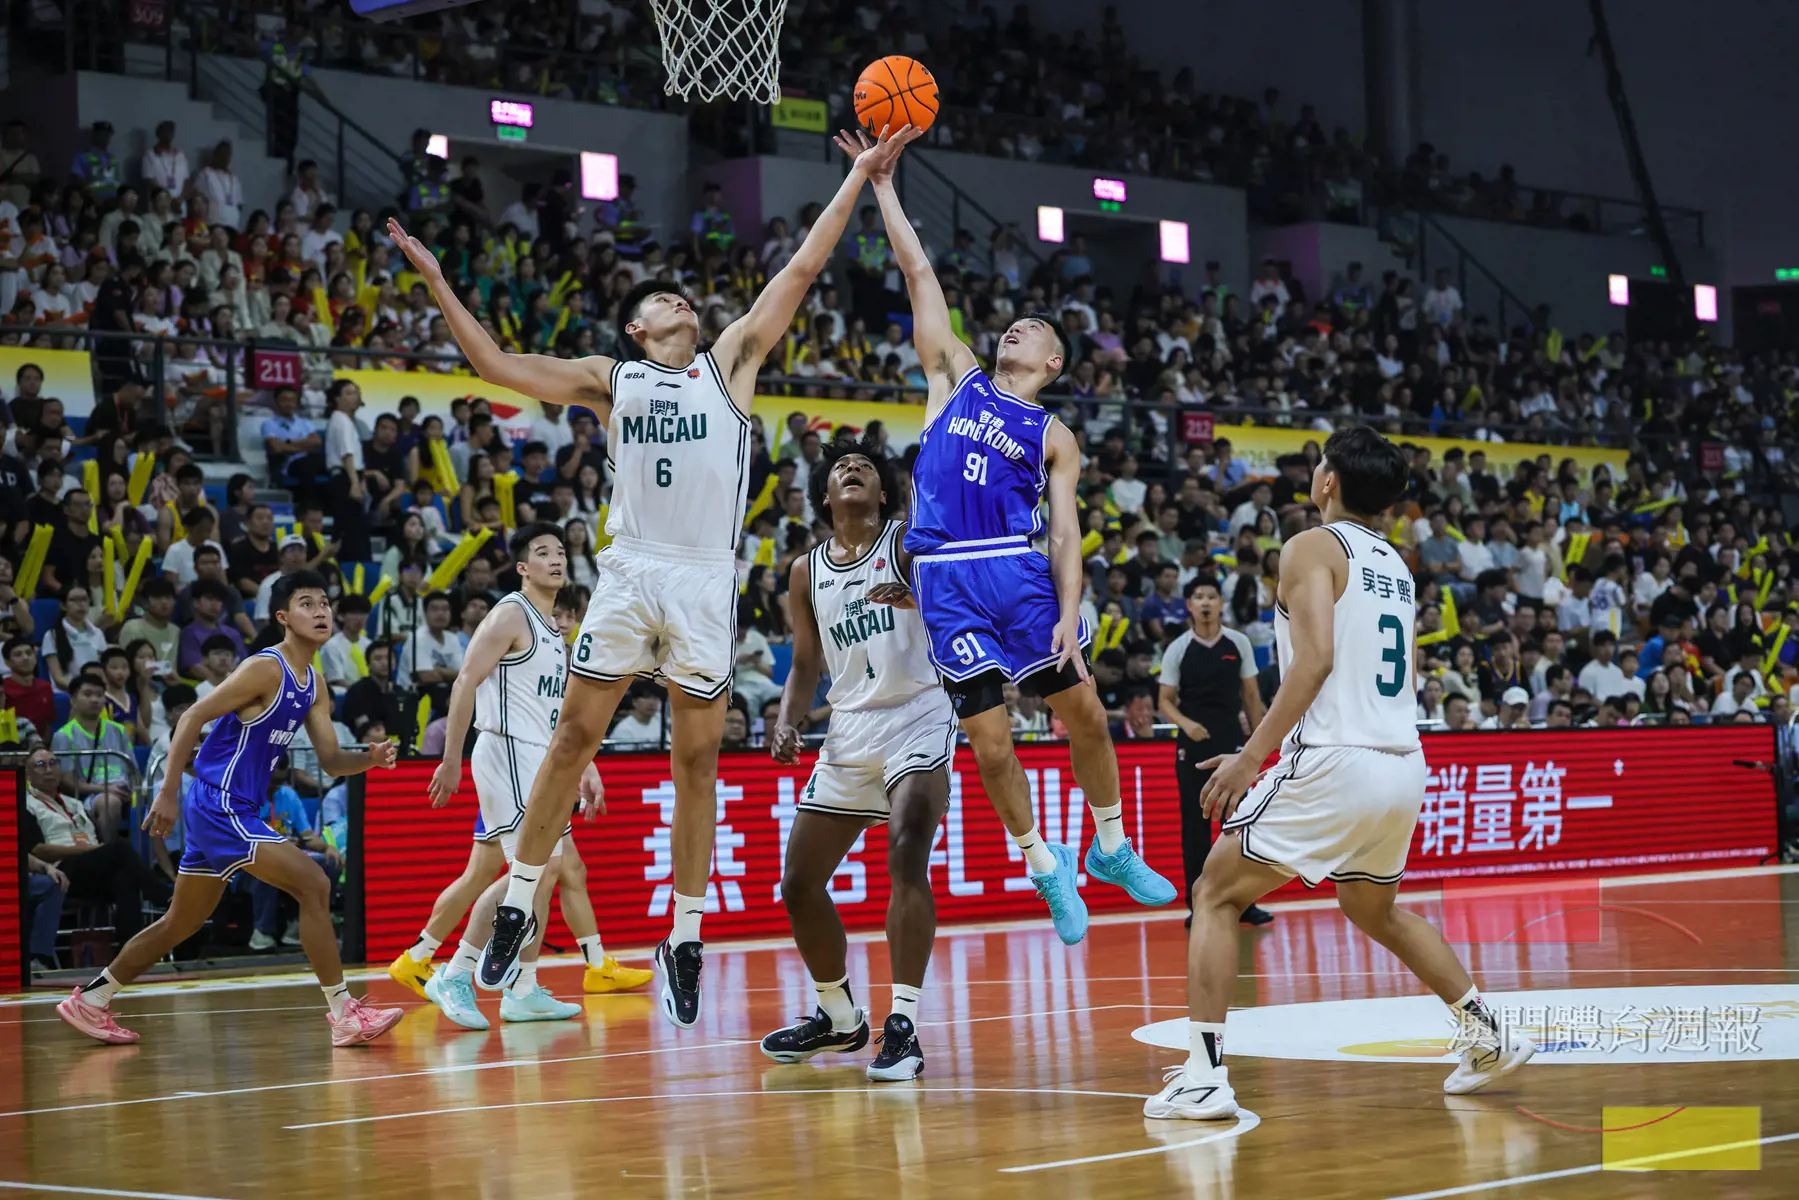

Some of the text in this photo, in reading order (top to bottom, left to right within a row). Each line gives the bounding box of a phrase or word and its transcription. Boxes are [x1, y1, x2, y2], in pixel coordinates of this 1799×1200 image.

[260, 359, 296, 383] 211
[649, 399, 679, 417] 澳門
[979, 410, 1006, 431] 香港
[622, 413, 707, 444] MACAU
[947, 416, 1026, 460] HONG KONG
[1186, 419, 1212, 439] 212
[656, 457, 673, 488] 6
[963, 451, 989, 486] 91
[828, 605, 895, 651] MACAU
[576, 632, 593, 663] 6
[952, 632, 987, 666] 91
[1375, 613, 1407, 698] 3
[806, 772, 818, 799] 4
